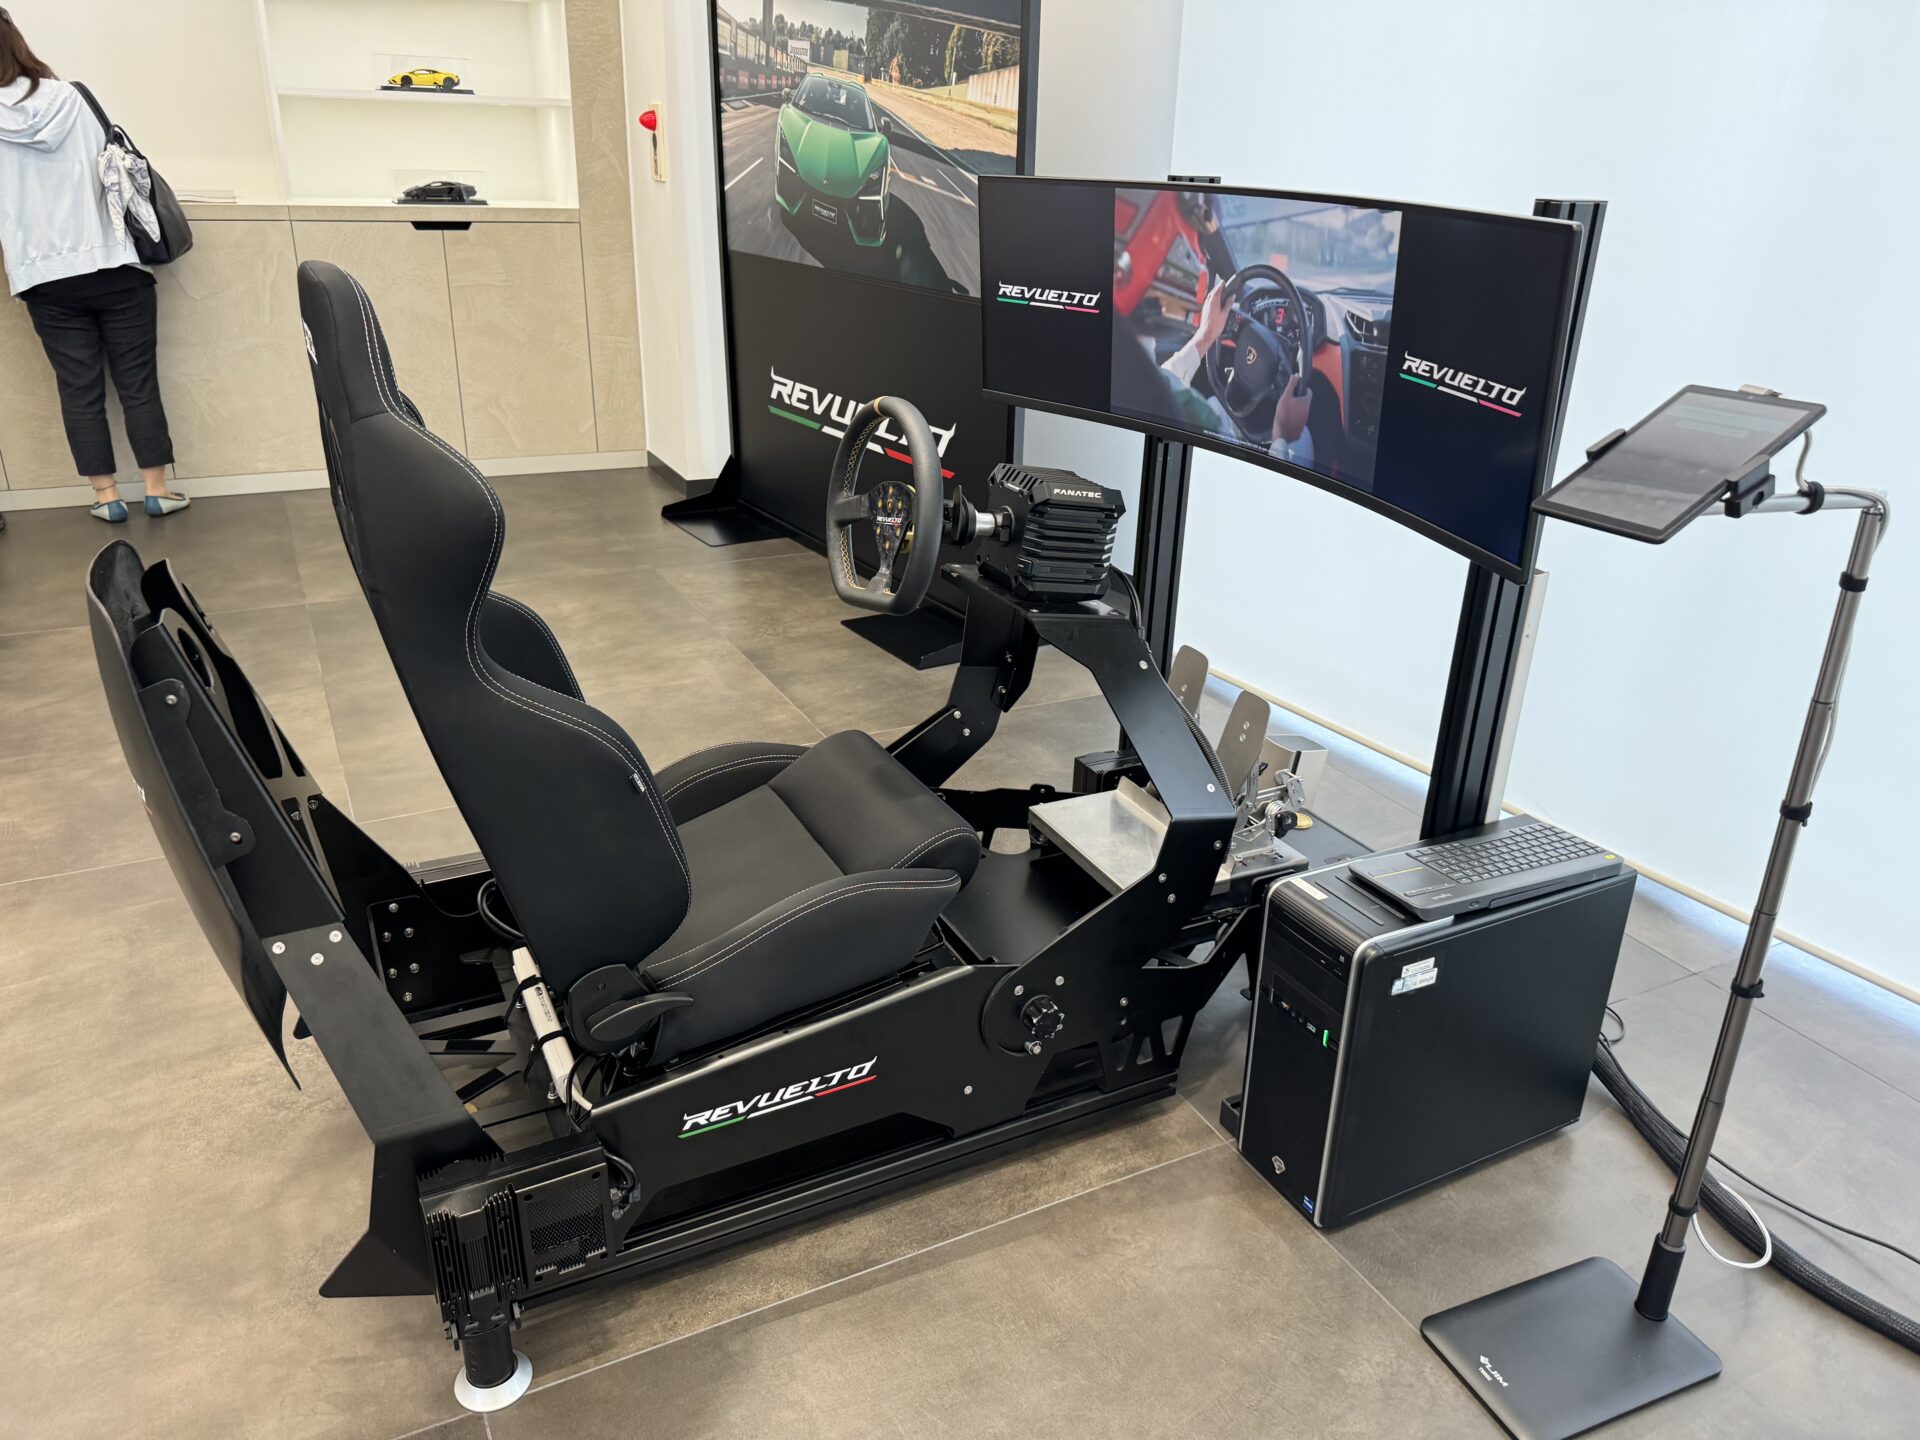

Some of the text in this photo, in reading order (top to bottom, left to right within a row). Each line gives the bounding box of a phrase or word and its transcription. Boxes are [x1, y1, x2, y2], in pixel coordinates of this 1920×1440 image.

[999, 281, 1101, 307] REVUELTO
[1402, 350, 1527, 406] REVUELTO
[1053, 488, 1102, 499] FANATEC
[682, 1056, 878, 1131] REVUELTO
